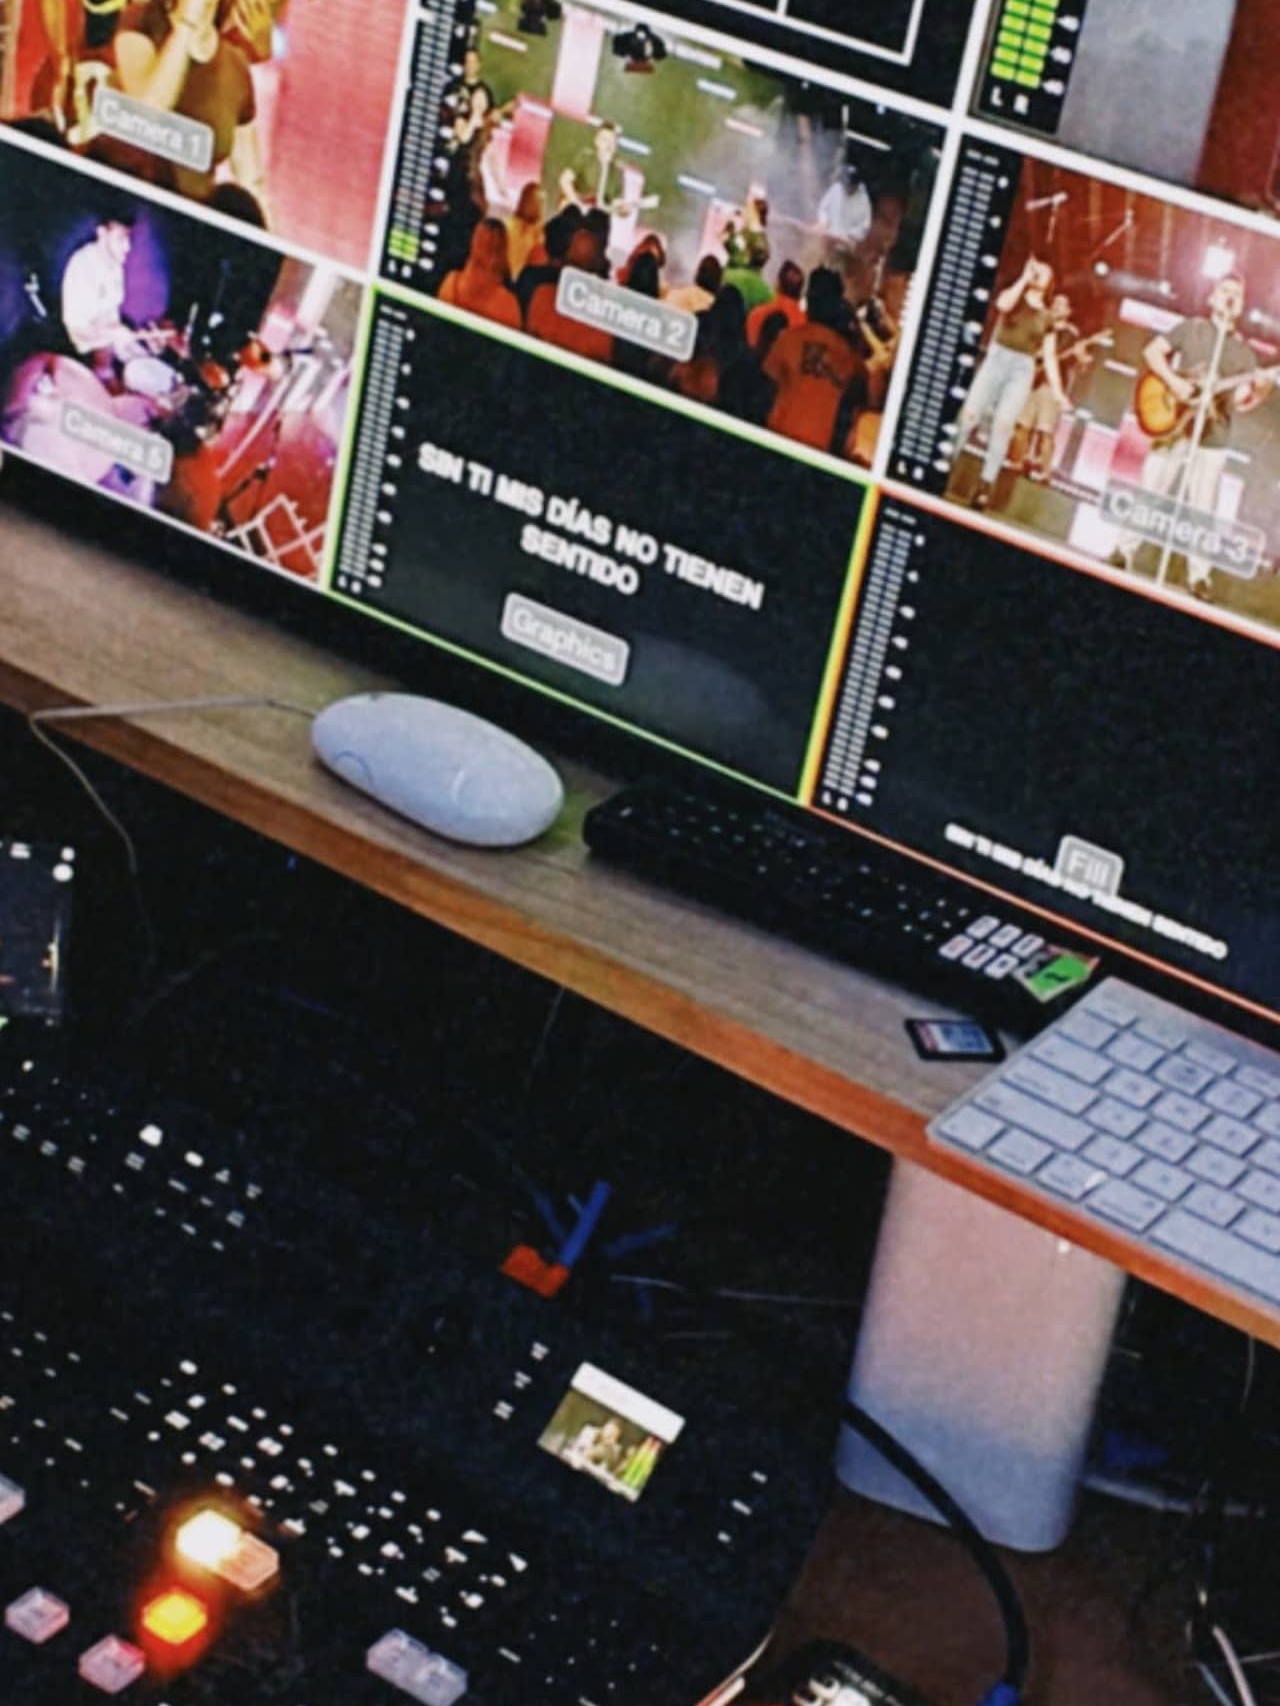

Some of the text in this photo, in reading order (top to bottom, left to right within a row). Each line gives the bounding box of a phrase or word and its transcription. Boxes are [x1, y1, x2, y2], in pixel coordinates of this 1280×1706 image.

[100, 97, 186, 151] Camera
[565, 280, 684, 345] Camera 2
[416, 441, 466, 484] SIN
[466, 460, 495, 496] TI
[494, 474, 546, 518] MIS
[614, 524, 659, 564] NO
[1107, 490, 1221, 554] Camera
[520, 523, 641, 596] SENTIDO
